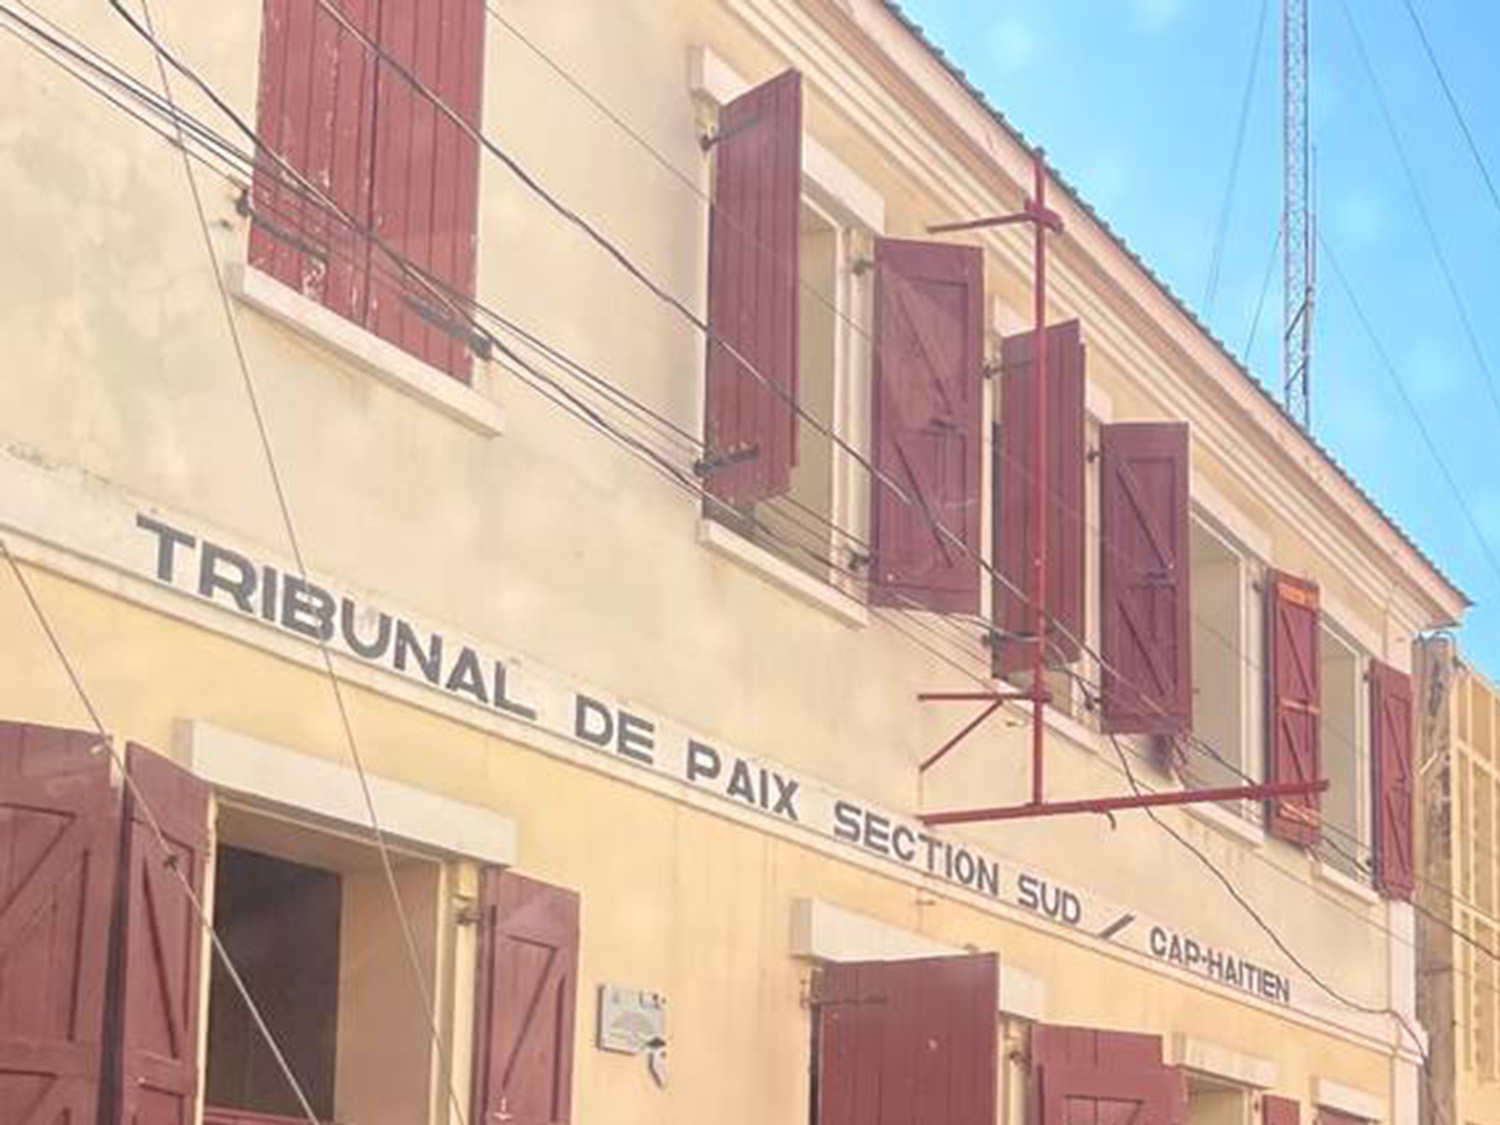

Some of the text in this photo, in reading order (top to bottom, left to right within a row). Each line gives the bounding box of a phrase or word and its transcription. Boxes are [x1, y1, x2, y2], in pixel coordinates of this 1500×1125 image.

[136, 513, 537, 721] TRIBUNAL
[574, 692, 656, 764] DE
[686, 738, 799, 822] PAIX
[834, 799, 999, 898] SECTION
[1017, 876, 1082, 925] SUD
[1149, 926, 1291, 1003] CAP-HAITIEN
